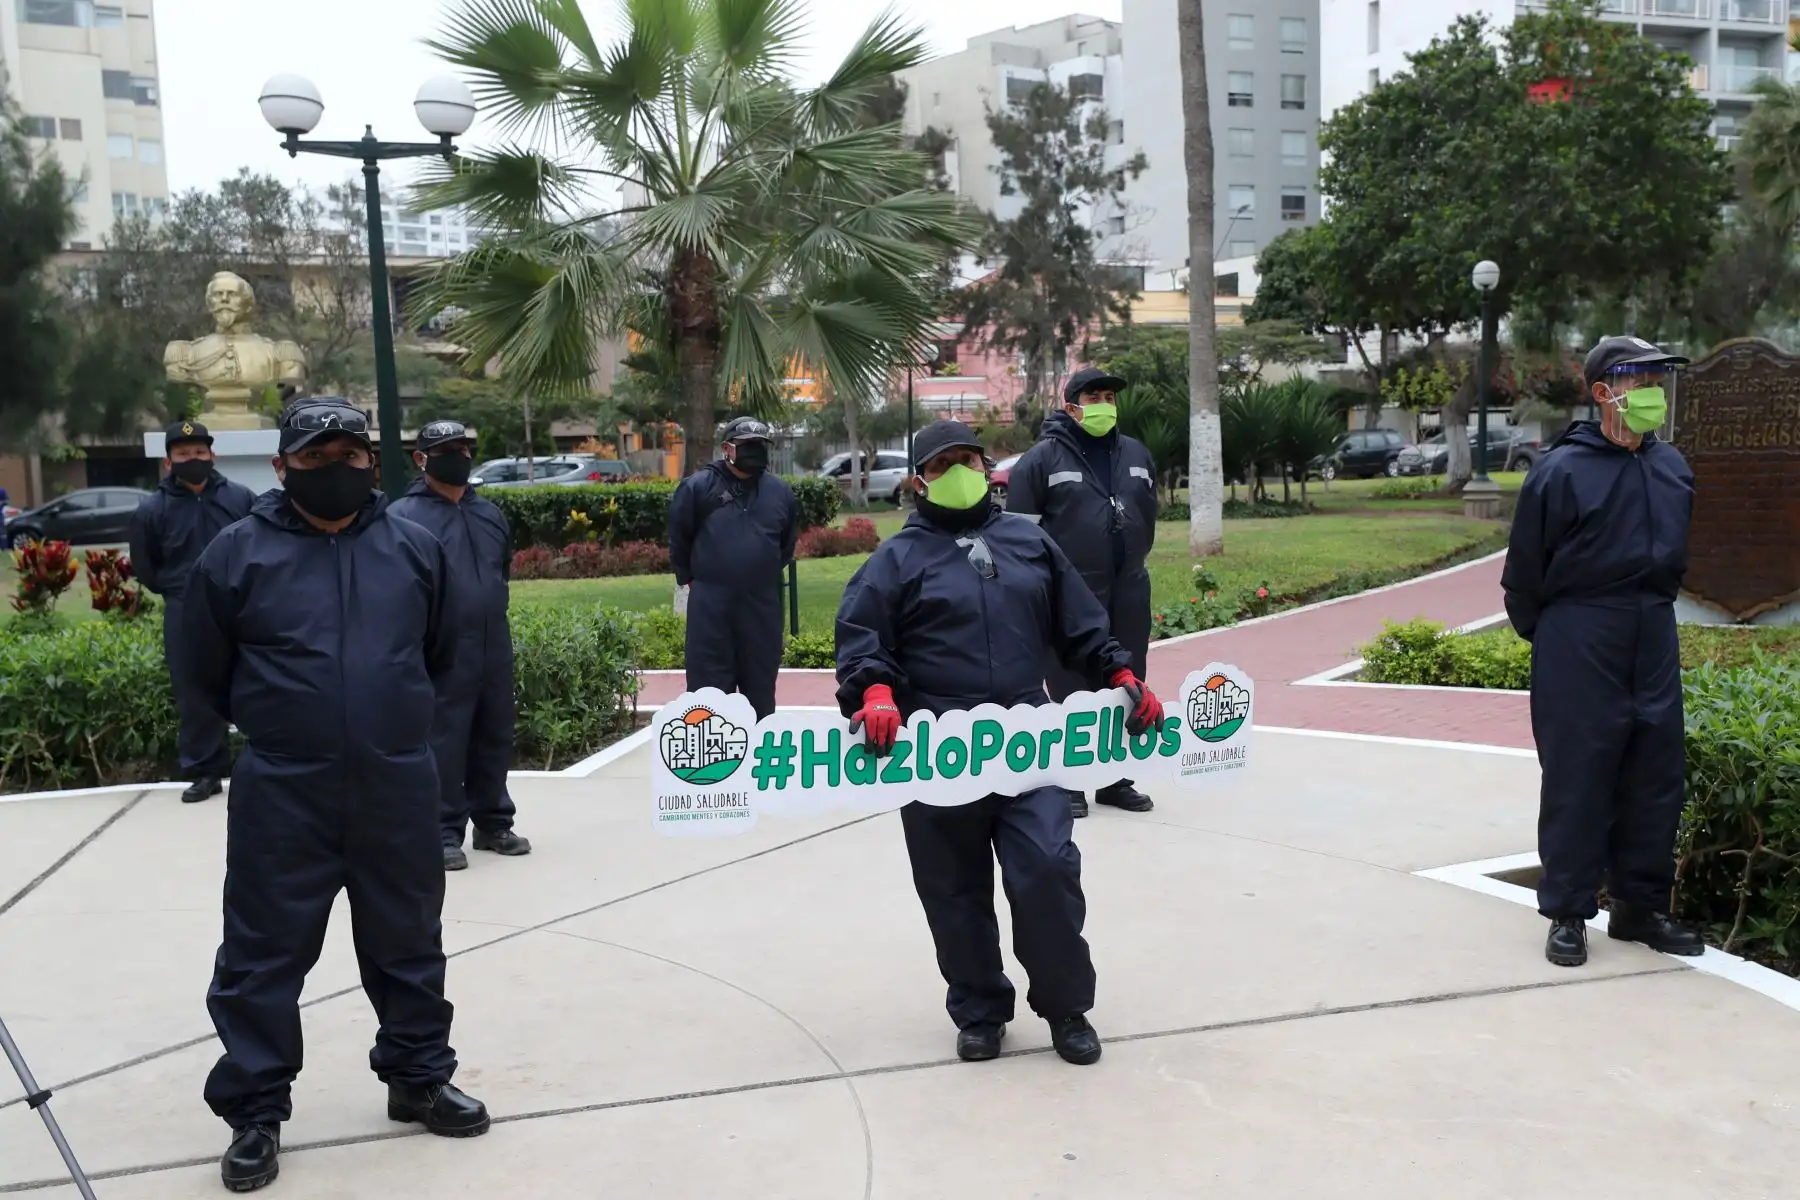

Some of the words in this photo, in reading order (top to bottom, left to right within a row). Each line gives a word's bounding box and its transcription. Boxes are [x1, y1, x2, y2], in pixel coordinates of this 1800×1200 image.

[751, 704, 1182, 791] #HazloPorEllos
[1181, 751, 1206, 767] CIUDAD
[1209, 745, 1246, 763] SALUDABLE
[658, 794, 692, 811] CIUDAD
[696, 791, 749, 809] SALUDABLE
[658, 813, 691, 822] CAMBIANDO
[691, 812, 713, 820] MENTES
[719, 810, 750, 819] CORAZONES
